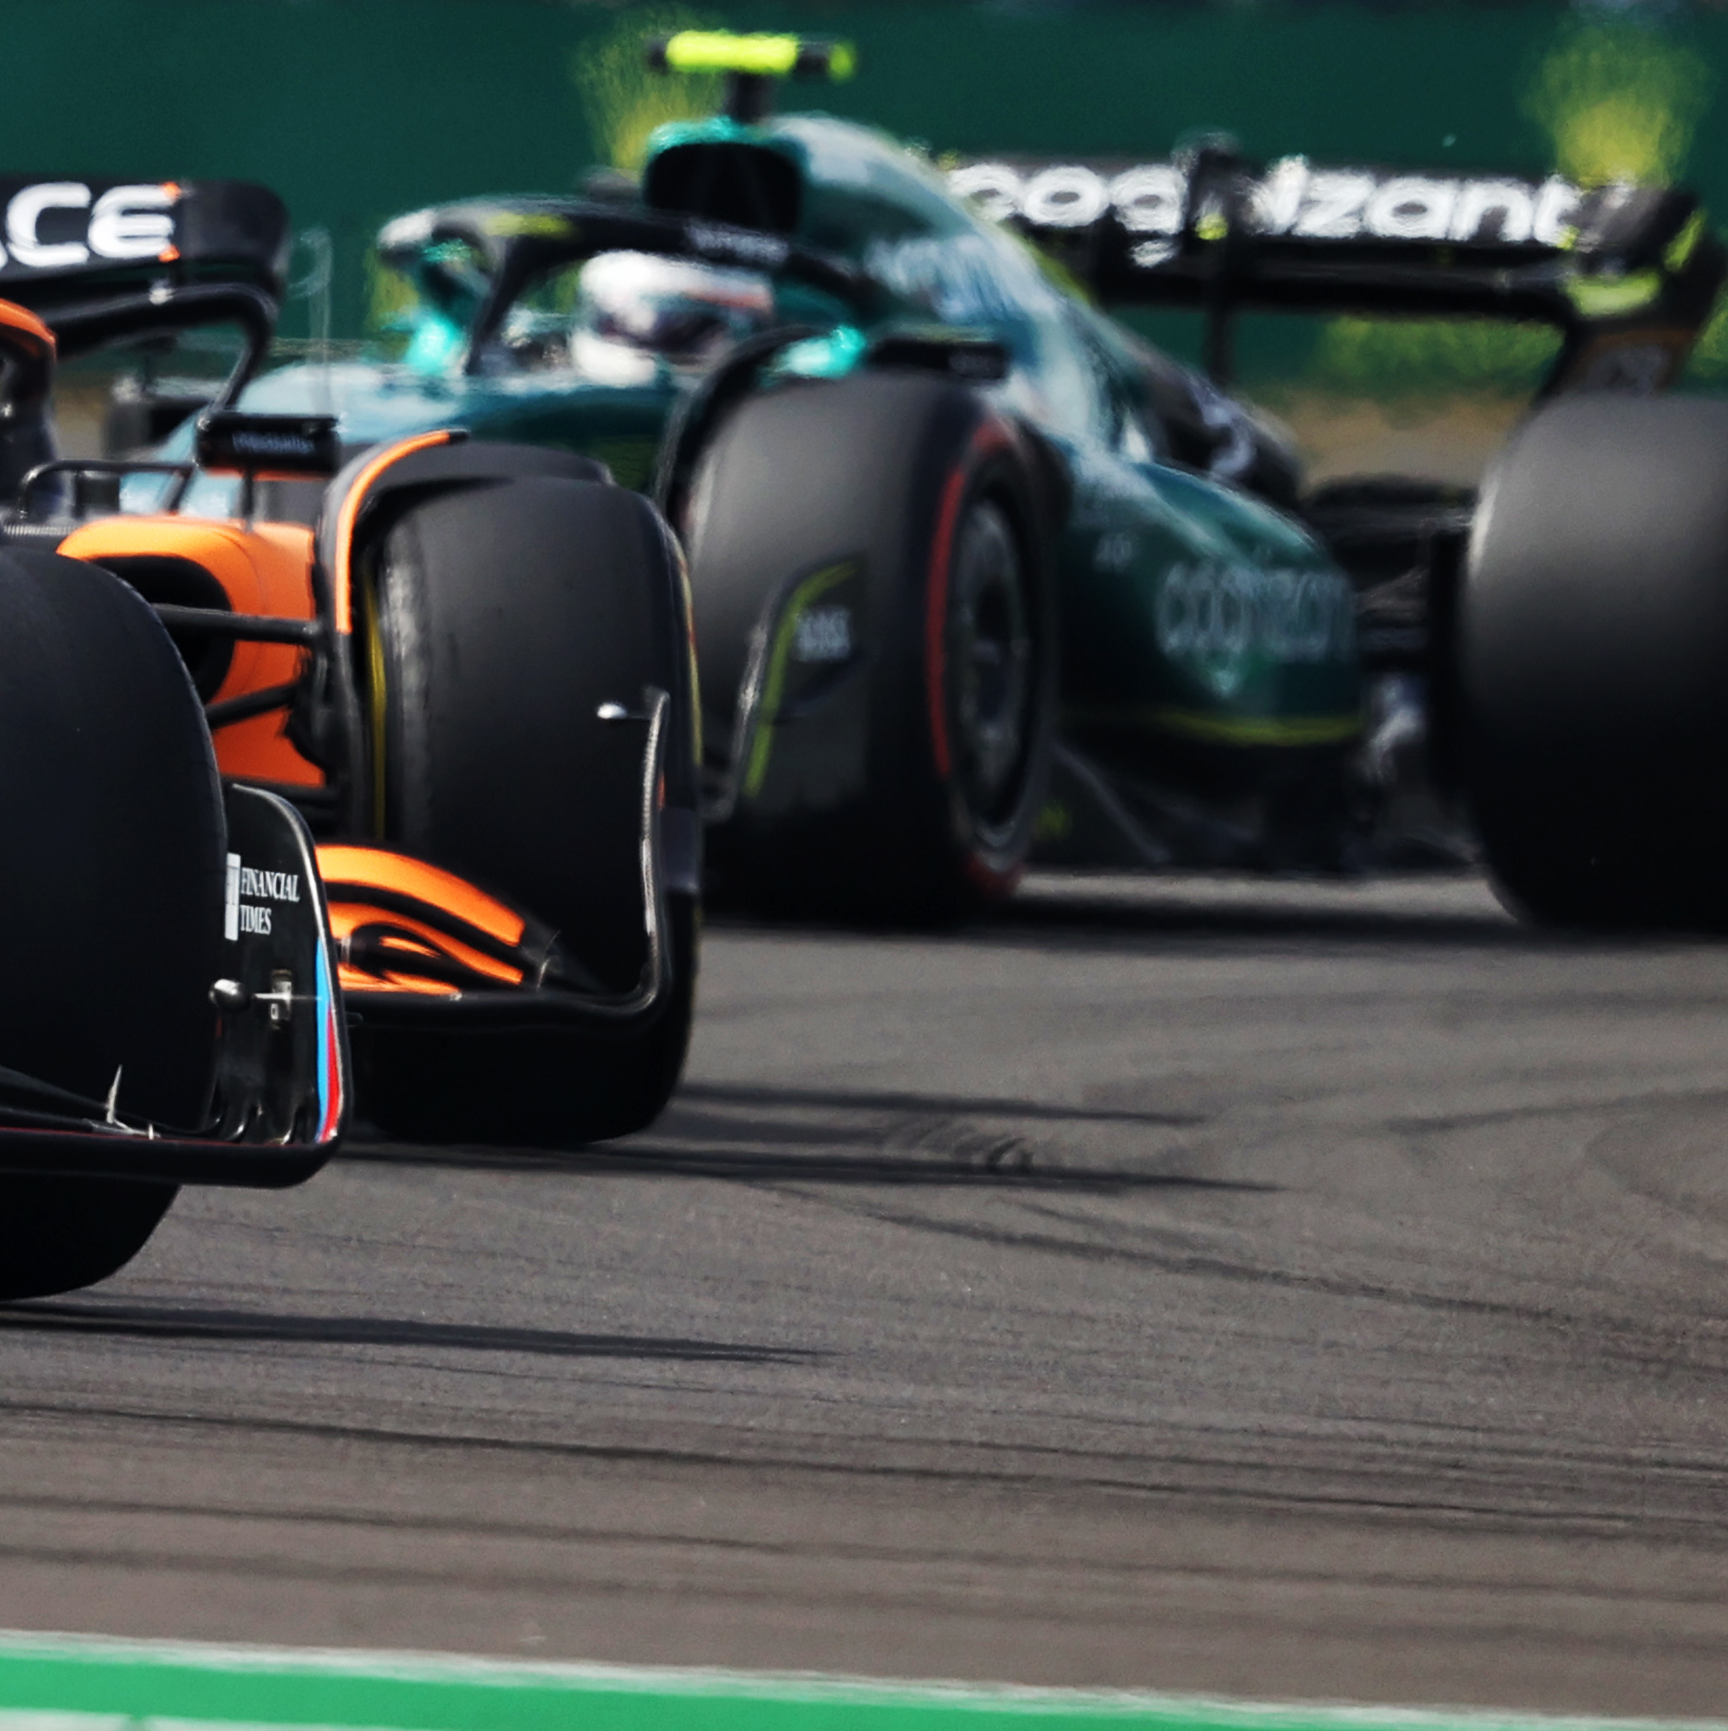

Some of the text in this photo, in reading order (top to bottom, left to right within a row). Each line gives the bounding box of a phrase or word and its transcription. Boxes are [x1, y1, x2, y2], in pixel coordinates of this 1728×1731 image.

[946, 155, 1580, 266] cogizant
[239, 867, 300, 903] FINANCIAL
[239, 904, 272, 936] TIMES
